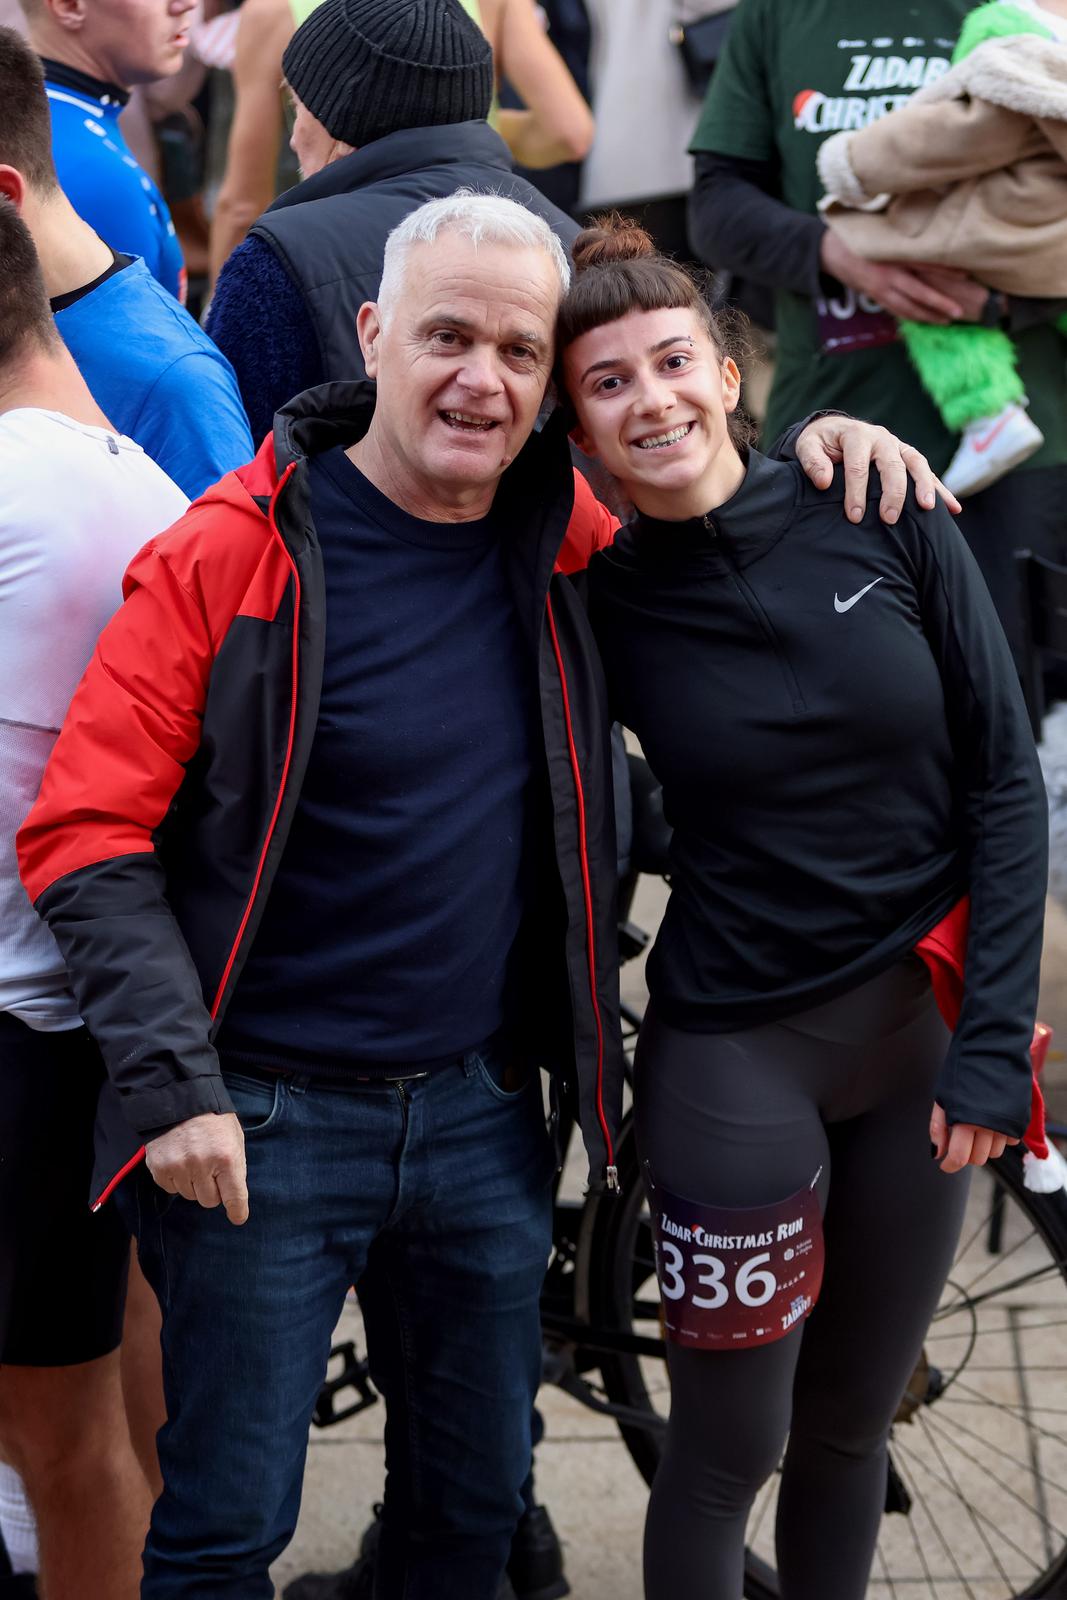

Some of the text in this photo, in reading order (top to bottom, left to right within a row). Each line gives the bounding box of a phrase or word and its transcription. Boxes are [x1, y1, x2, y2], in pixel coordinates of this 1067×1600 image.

[661, 1212, 692, 1243] ZADAR
[693, 1225, 774, 1250] CHRISTMAS
[776, 1217, 804, 1242] RUN
[661, 1241, 777, 1310] 336
